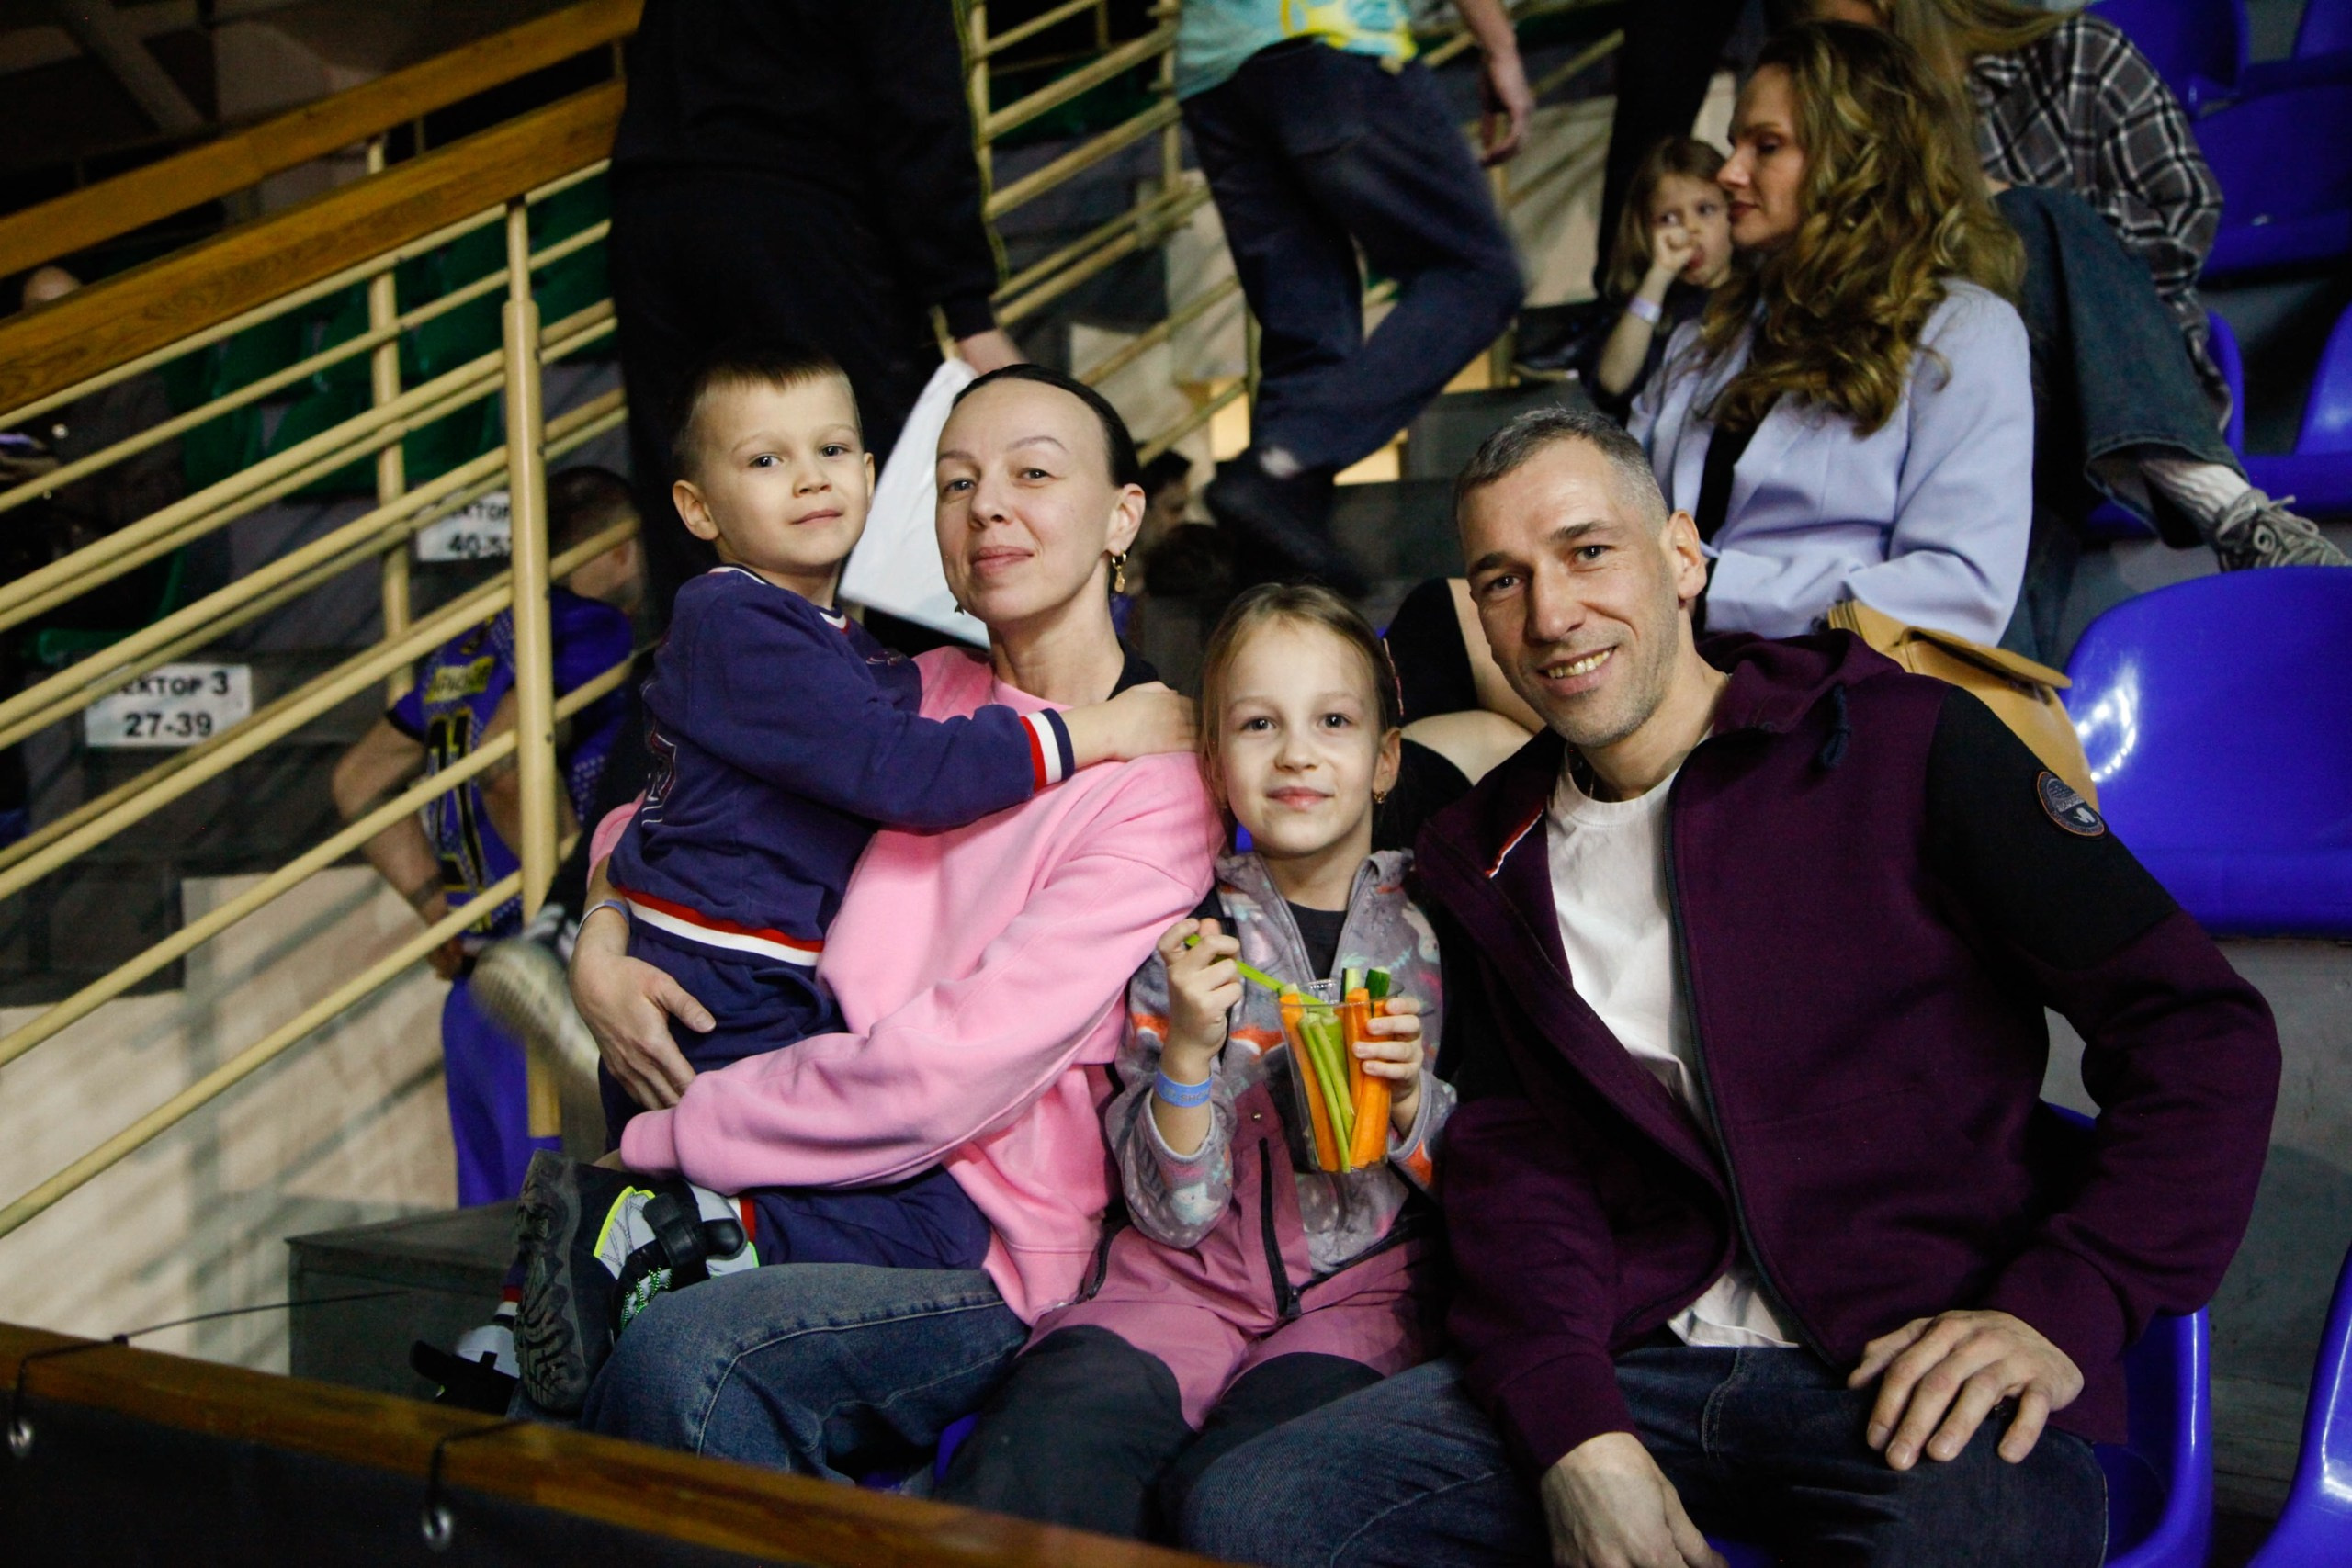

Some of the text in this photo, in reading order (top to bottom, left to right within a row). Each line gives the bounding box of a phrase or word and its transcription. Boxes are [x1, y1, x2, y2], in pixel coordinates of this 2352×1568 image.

[122, 671, 228, 695] ЕКТОР 3
[125, 713, 212, 736] 27-39
